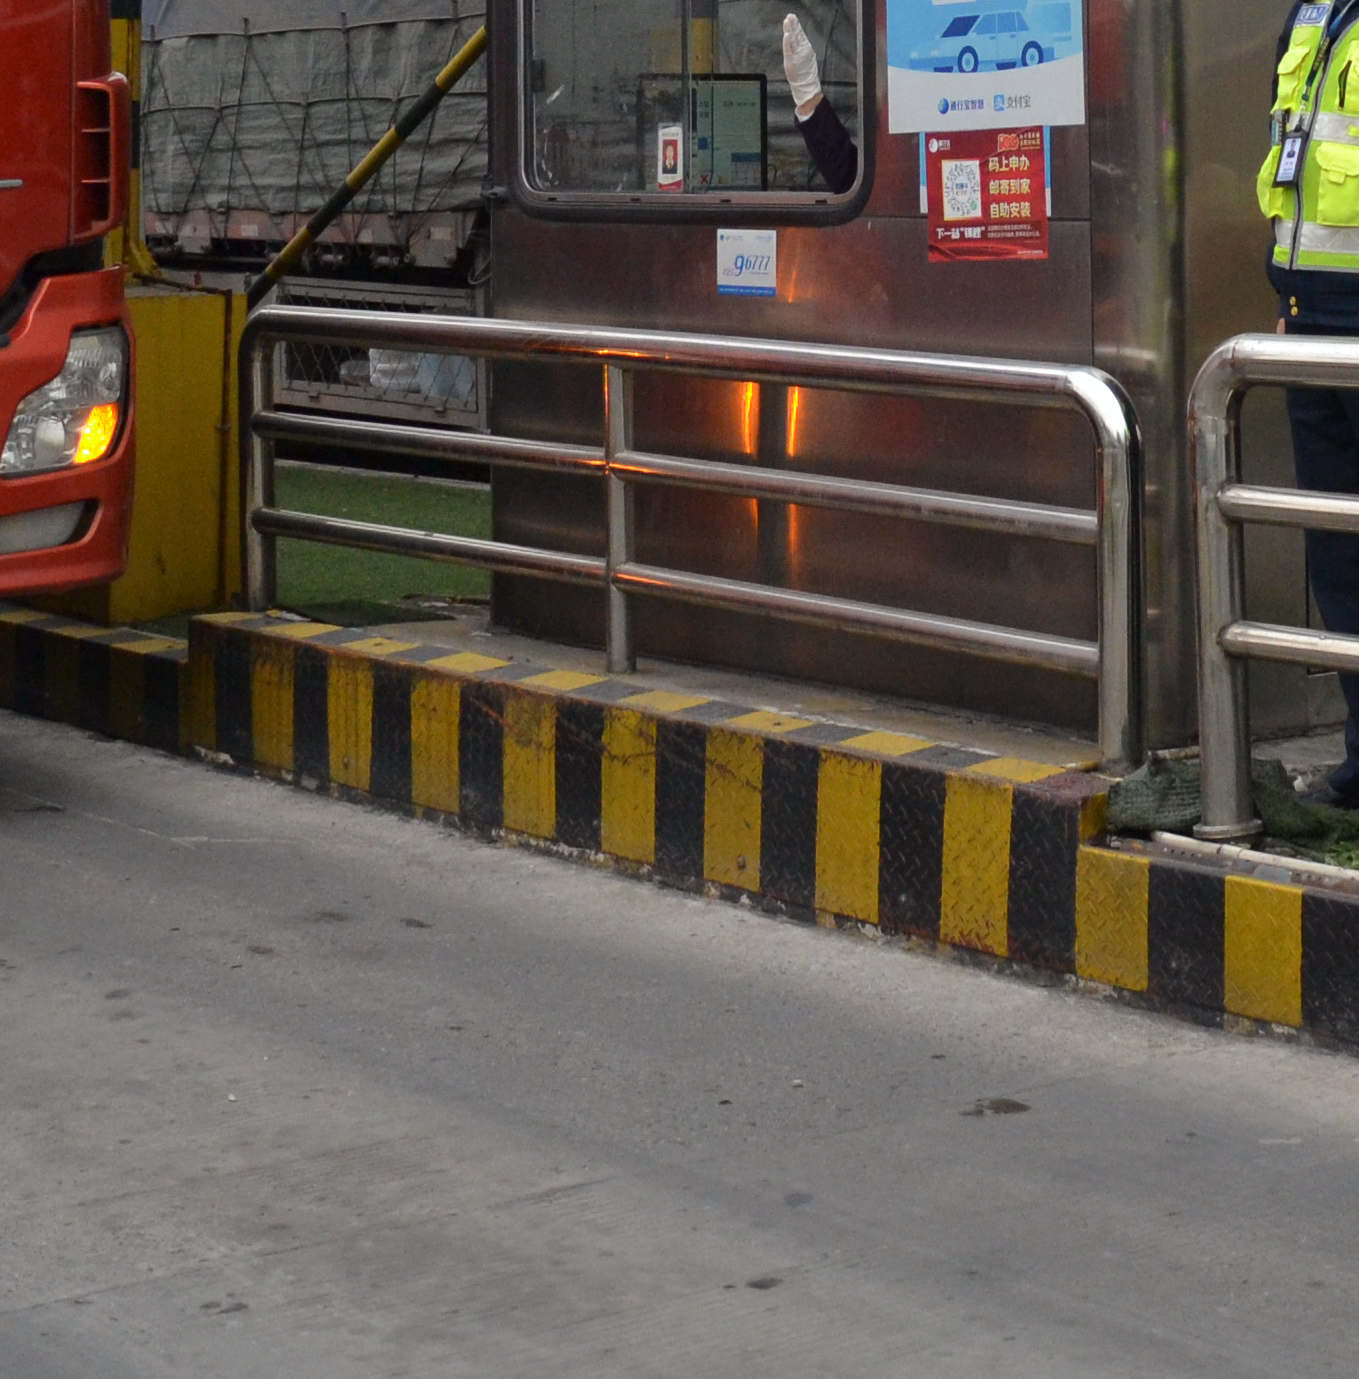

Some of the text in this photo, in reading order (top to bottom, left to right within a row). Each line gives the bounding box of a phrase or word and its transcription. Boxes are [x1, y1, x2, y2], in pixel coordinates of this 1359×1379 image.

[1007, 95, 1031, 109] 支付宝
[989, 155, 1030, 172] 码上申办
[989, 178, 1031, 195] 邮寄到家
[990, 202, 1031, 219] 自助安装
[735, 255, 771, 277] 96777
